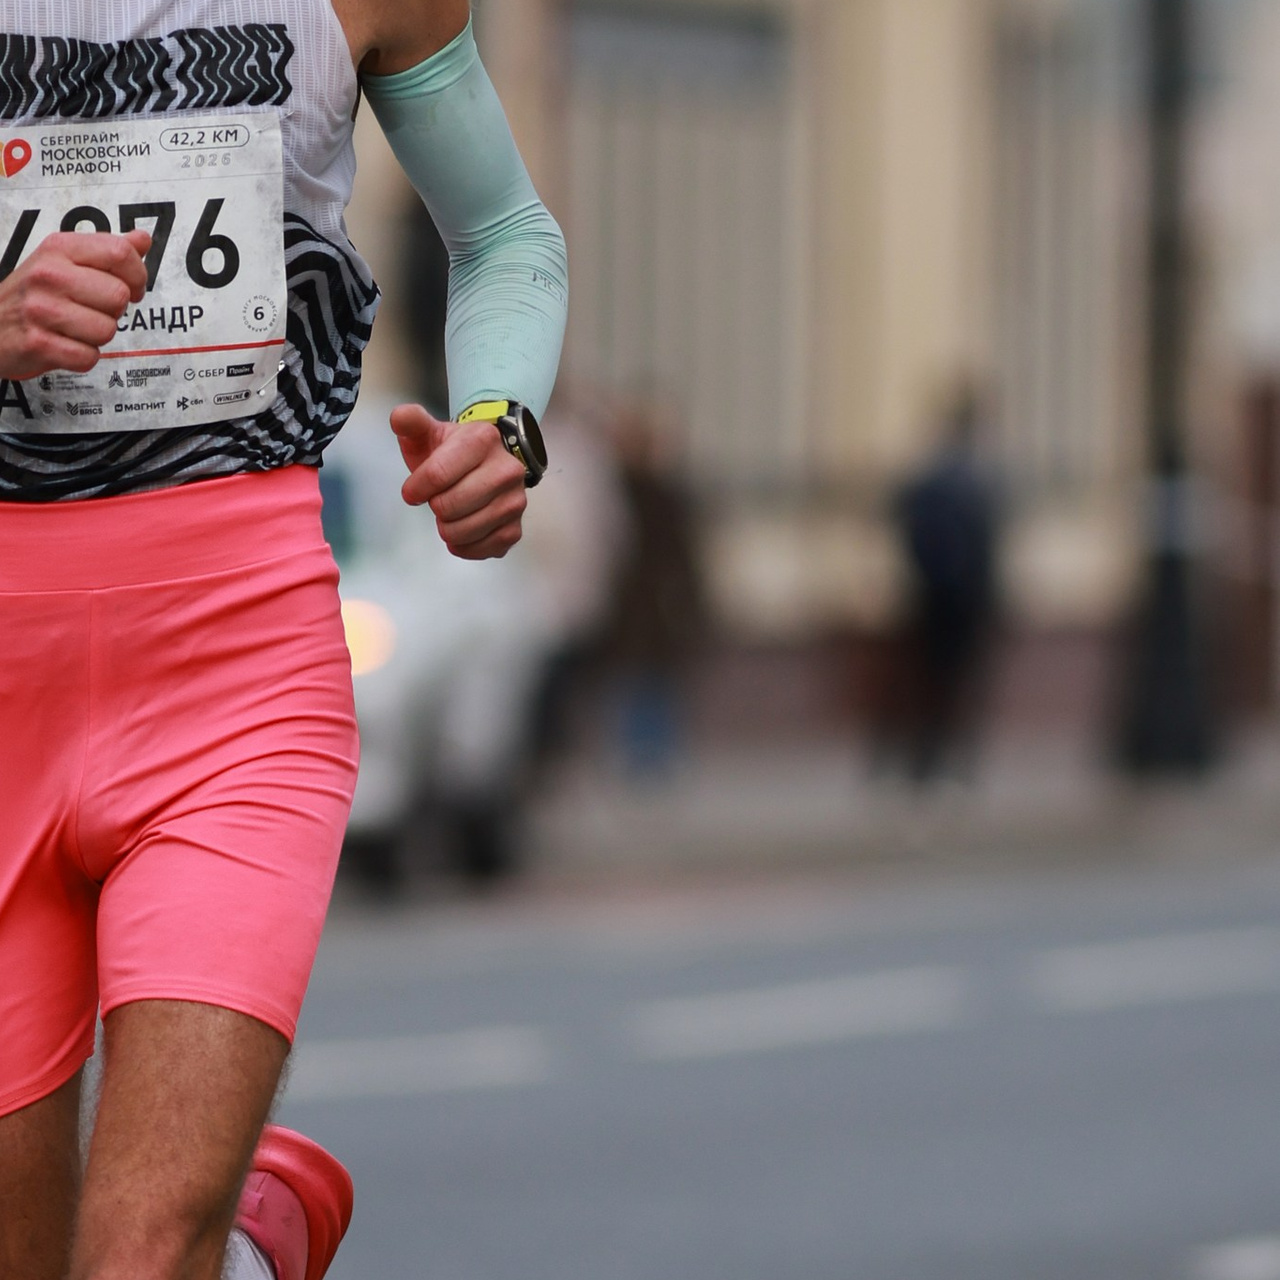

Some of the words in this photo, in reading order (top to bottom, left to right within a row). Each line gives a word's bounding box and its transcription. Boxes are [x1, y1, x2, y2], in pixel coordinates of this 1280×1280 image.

[166, 22, 295, 110] TRUST
[40, 133, 120, 147] СБЕРПРАЙМ
[169, 131, 206, 148] 42,2
[41, 141, 151, 162] МОСКОВСКИЙ
[41, 160, 122, 177] МАРАФОН
[253, 306, 265, 321] 6
[198, 368, 225, 378] СБЕР
[124, 401, 166, 412] магнит
